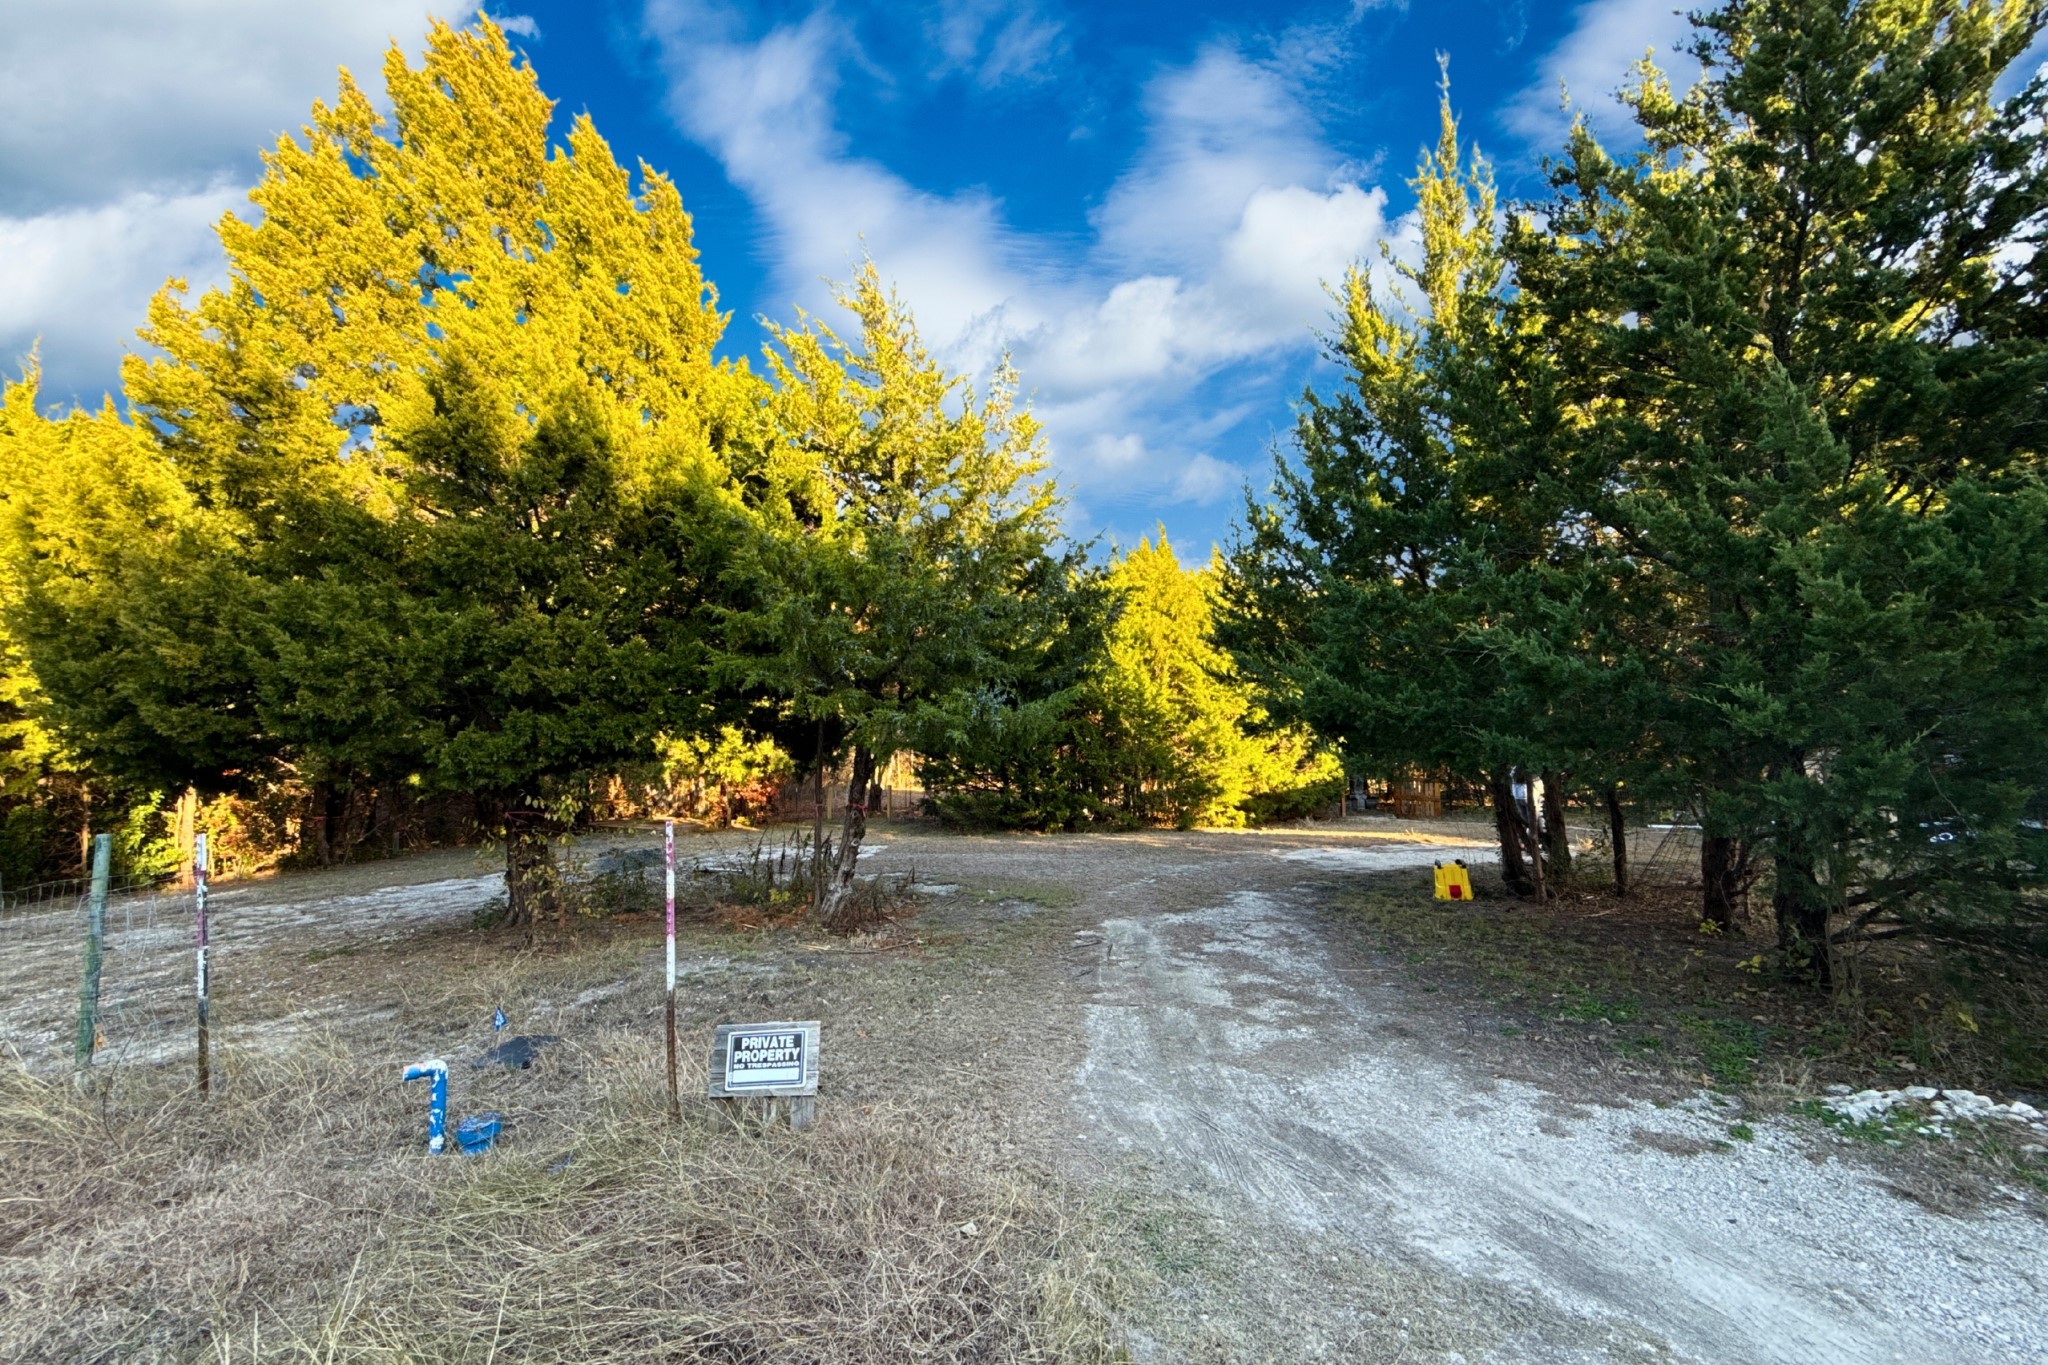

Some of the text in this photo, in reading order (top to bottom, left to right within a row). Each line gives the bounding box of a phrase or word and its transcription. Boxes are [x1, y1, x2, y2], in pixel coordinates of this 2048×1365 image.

[741, 1035, 795, 1050] PRIVATE
[734, 1047, 800, 1063] PROPERTY
[747, 1061, 800, 1069] TRESPASSING
